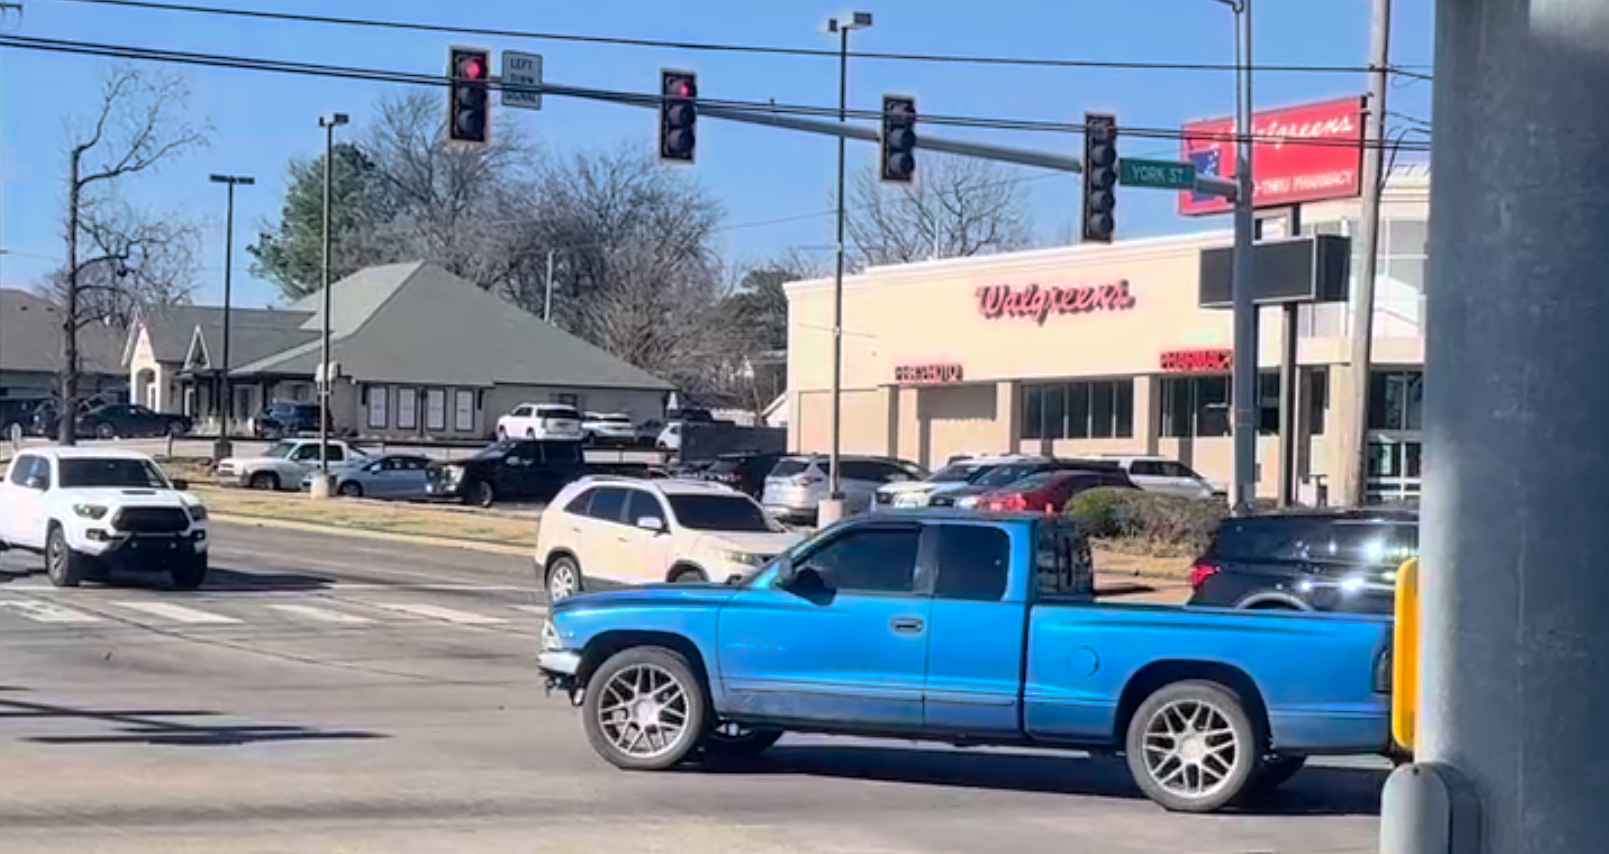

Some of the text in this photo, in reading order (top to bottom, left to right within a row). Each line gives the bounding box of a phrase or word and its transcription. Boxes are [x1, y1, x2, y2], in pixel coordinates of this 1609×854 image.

[510, 58, 534, 70] LEFT
[1130, 165, 1184, 184] YORK ST
[1292, 170, 1354, 193] PHARMACY
[975, 279, 1137, 327] Walgreens
